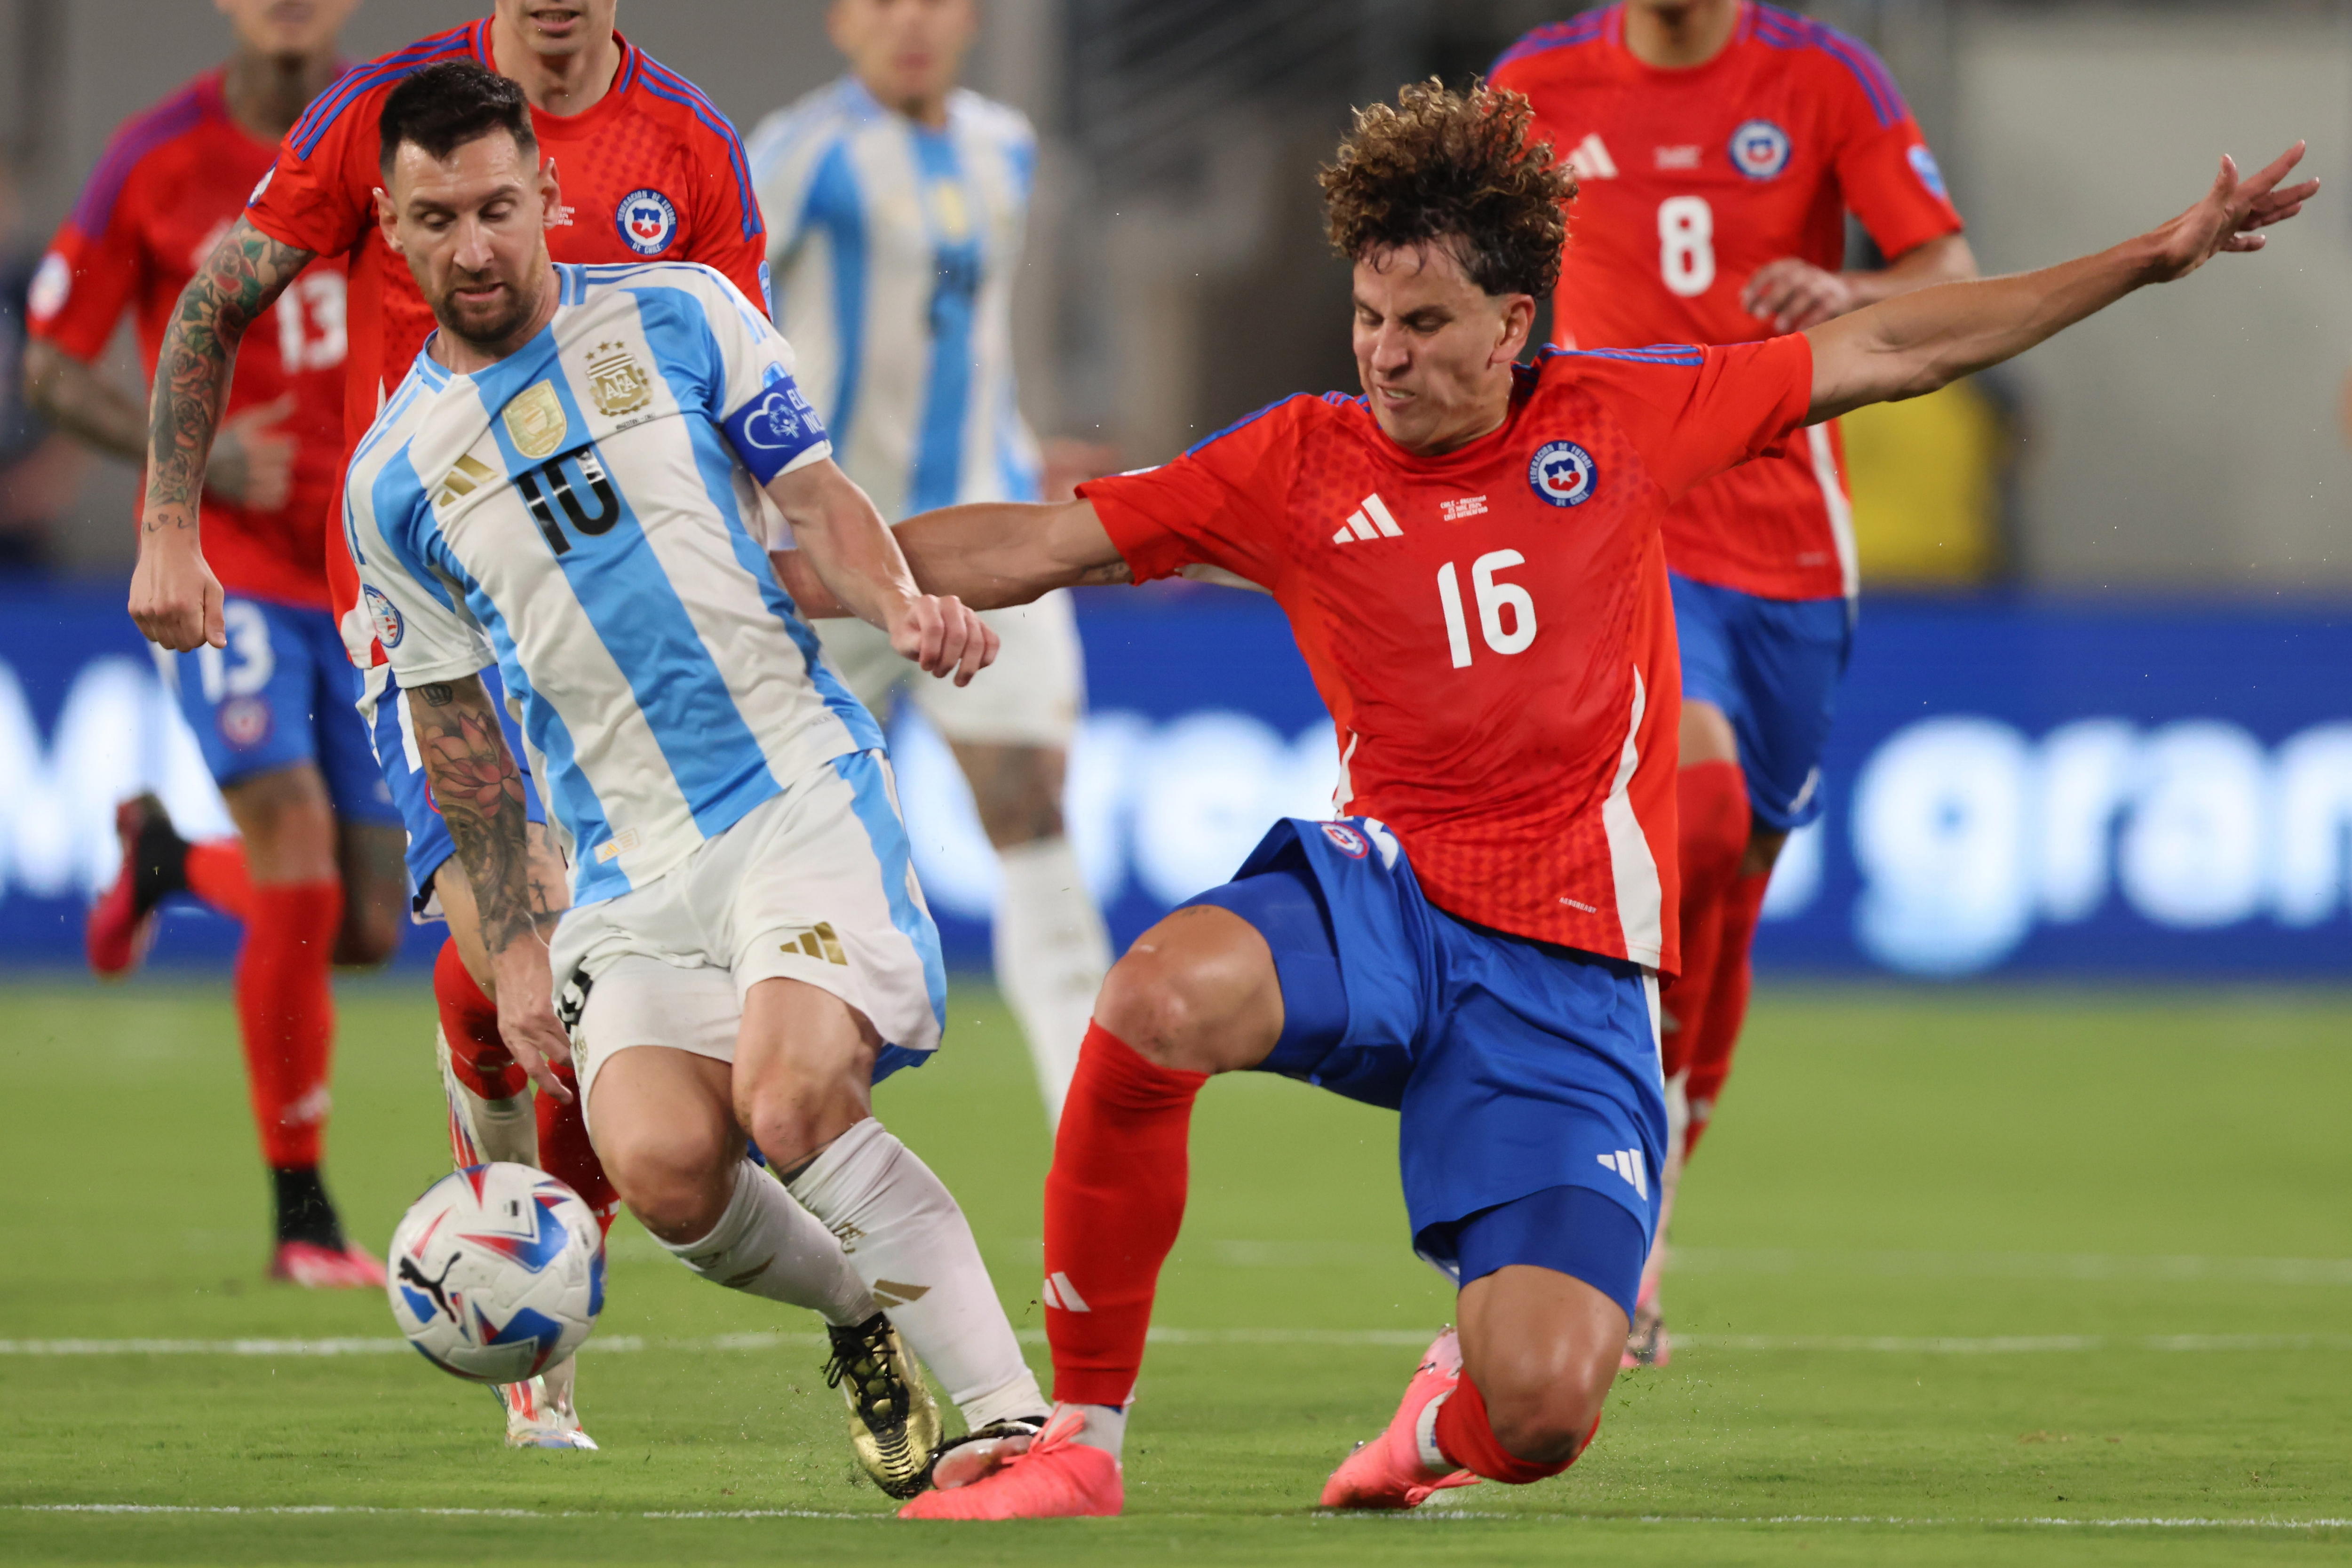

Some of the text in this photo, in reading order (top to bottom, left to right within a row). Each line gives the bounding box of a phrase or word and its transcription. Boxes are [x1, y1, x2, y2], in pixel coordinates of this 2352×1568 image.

[652, 192, 661, 202] DE
[632, 242, 662, 255] DE CHILE
[1657, 195, 1716, 297] 8
[277, 270, 347, 372] 13
[603, 368, 638, 400] AFA
[1558, 443, 1568, 451] DE
[1571, 446, 1593, 469] FUTBOL
[516, 444, 620, 556] 10
[1440, 500, 1454, 509] CHILE
[1460, 494, 1487, 504] ARGENTINA
[1570, 490, 1590, 505] CHILE
[1437, 548, 1537, 669] 16
[198, 599, 274, 704] 13
